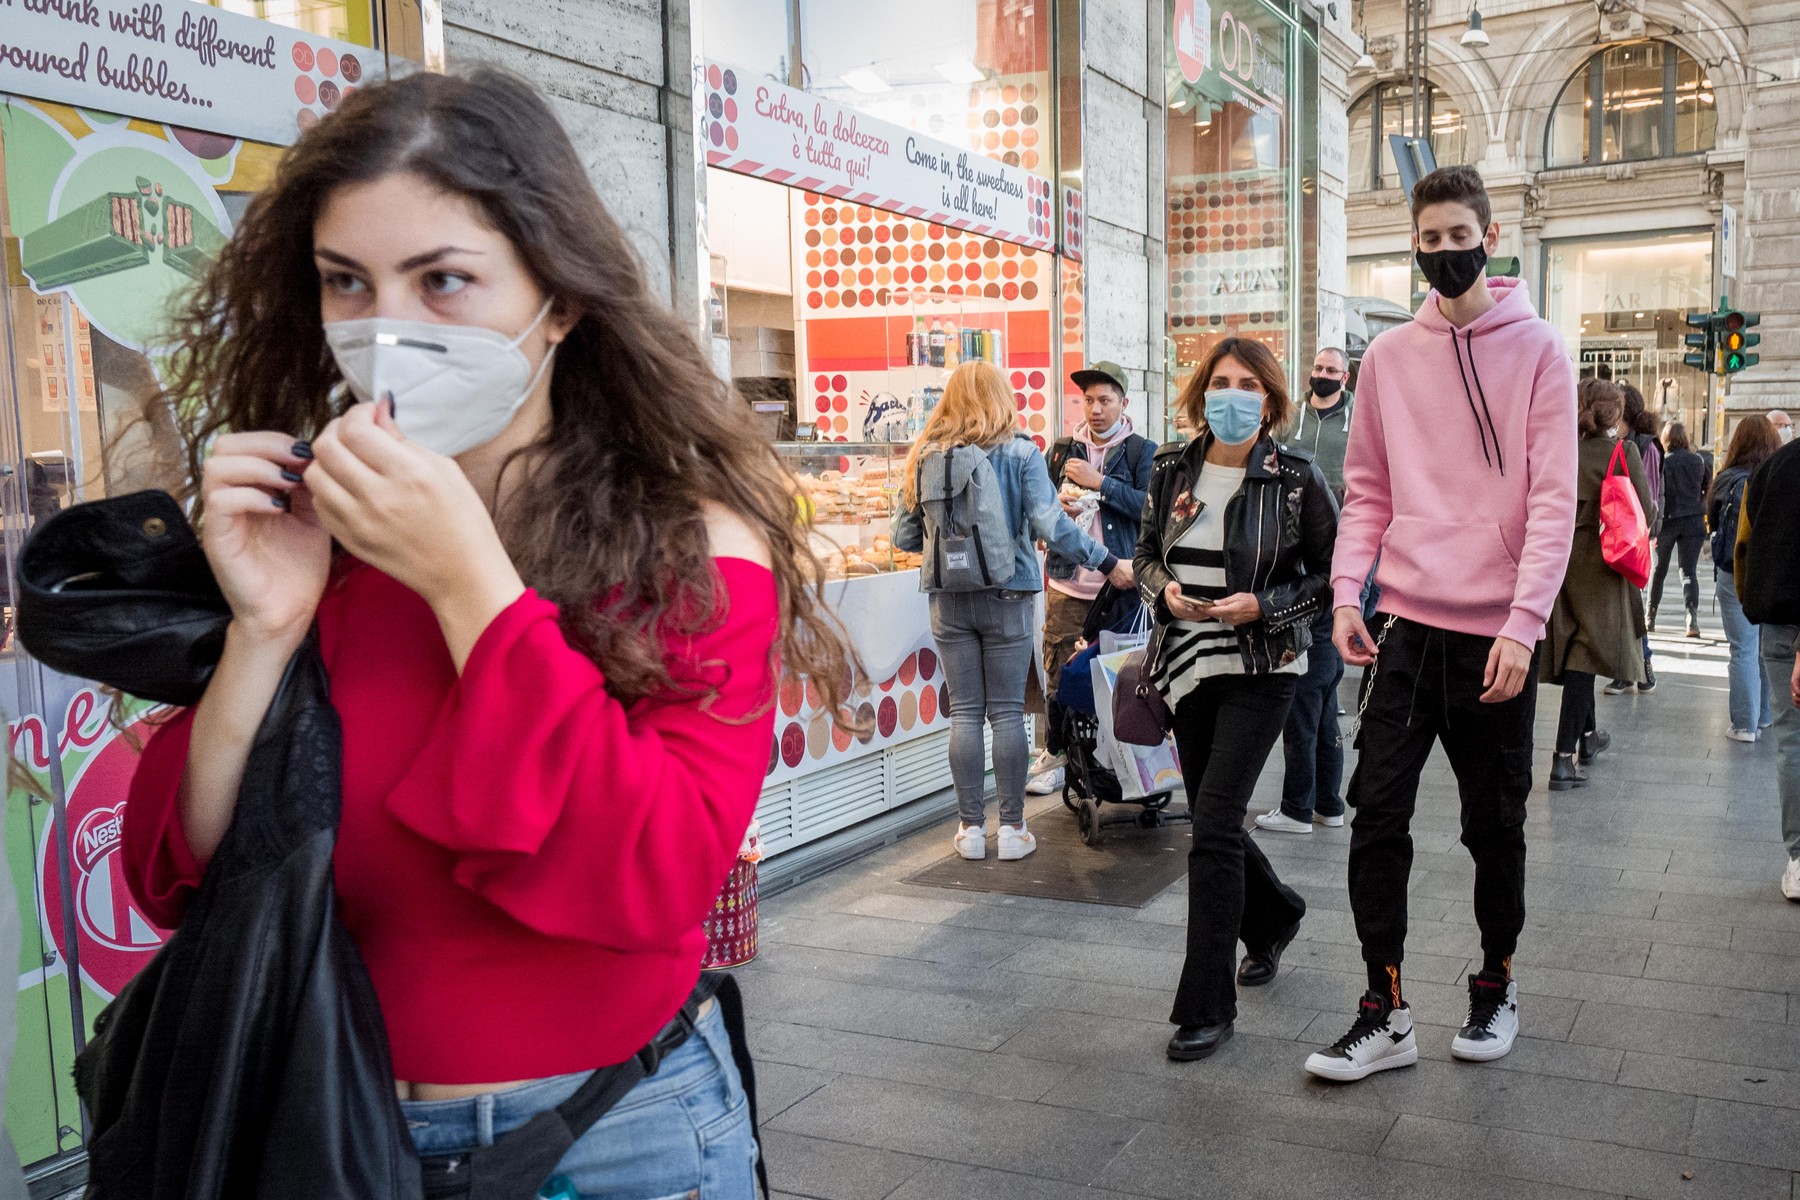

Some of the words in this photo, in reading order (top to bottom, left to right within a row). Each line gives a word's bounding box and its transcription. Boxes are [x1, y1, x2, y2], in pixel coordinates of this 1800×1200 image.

[108, 3, 166, 43] with
[175, 11, 276, 69] different
[97, 46, 213, 109] bubbles...
[755, 86, 808, 135] Entra,
[814, 103, 828, 136] la
[832, 110, 889, 156] dolcezza
[792, 133, 801, 159] è
[805, 136, 841, 171] tutta
[846, 154, 871, 187] qui!
[905, 136, 938, 171] Come
[941, 152, 953, 180] in,
[957, 152, 974, 183] the
[976, 168, 1024, 199] sweetness
[942, 185, 951, 209] is
[953, 184, 969, 213] all
[971, 188, 998, 221] here!
